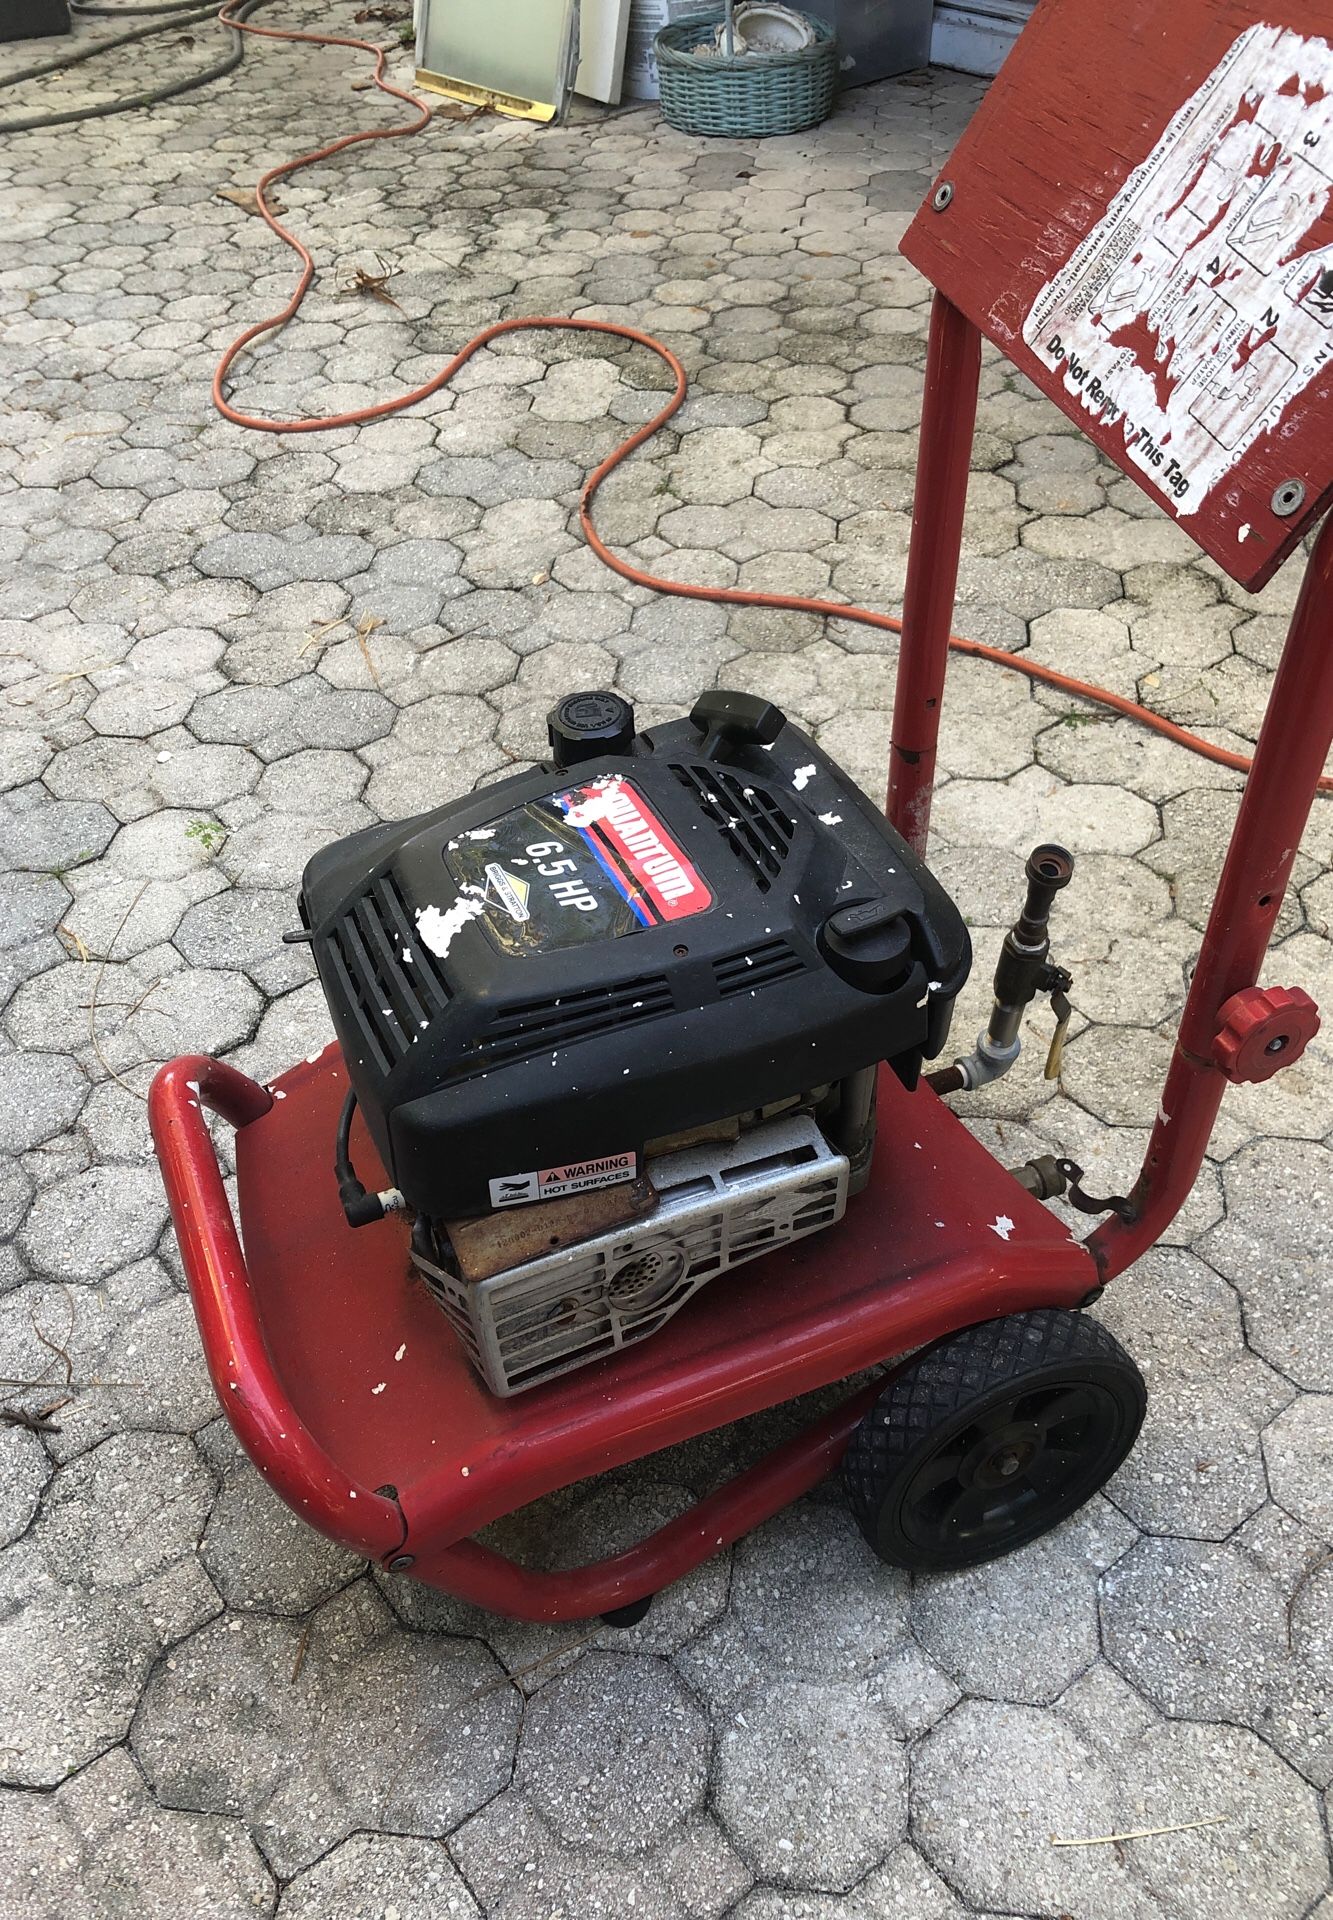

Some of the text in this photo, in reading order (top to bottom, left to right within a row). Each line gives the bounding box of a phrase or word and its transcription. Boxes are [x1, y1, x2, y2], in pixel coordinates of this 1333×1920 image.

[1173, 104, 1196, 131] unit
[1210, 102, 1233, 130] START
[1164, 131, 1176, 145] is
[1304, 130, 1320, 149] 3
[1122, 144, 1166, 203] equipped
[1104, 203, 1126, 230] with
[1098, 216, 1131, 259] KICKBACK
[1112, 235, 1136, 266] ENGINE
[1062, 229, 1109, 287] automatic
[1206, 256, 1221, 276] 4
[1080, 281, 1090, 292] TO
[1092, 266, 1112, 292] FALSE
[1173, 268, 1188, 287] AND
[1062, 291, 1082, 315] AVOID
[1069, 296, 1084, 314] AND
[1069, 292, 1093, 322] STARTS
[1161, 287, 1175, 303] SET
[1033, 287, 1067, 330] thermal
[1260, 307, 1280, 327] 2
[1216, 321, 1249, 363] CONNECT
[1224, 317, 1244, 342] TURN
[1102, 359, 1120, 381] FAST
[1196, 363, 1217, 389] HOSE
[1046, 334, 1066, 360] Do
[1064, 352, 1091, 383] Not
[1130, 428, 1165, 466] This
[1162, 459, 1191, 499] Tag
[604, 791, 695, 902] QUANTUM
[525, 841, 599, 912] 6.5 HP
[489, 865, 506, 887] BRIGGS
[504, 889, 525, 919] STRATTON
[564, 1157, 628, 1179] WARNING
[544, 1171, 629, 1195] HOT SURFACES
